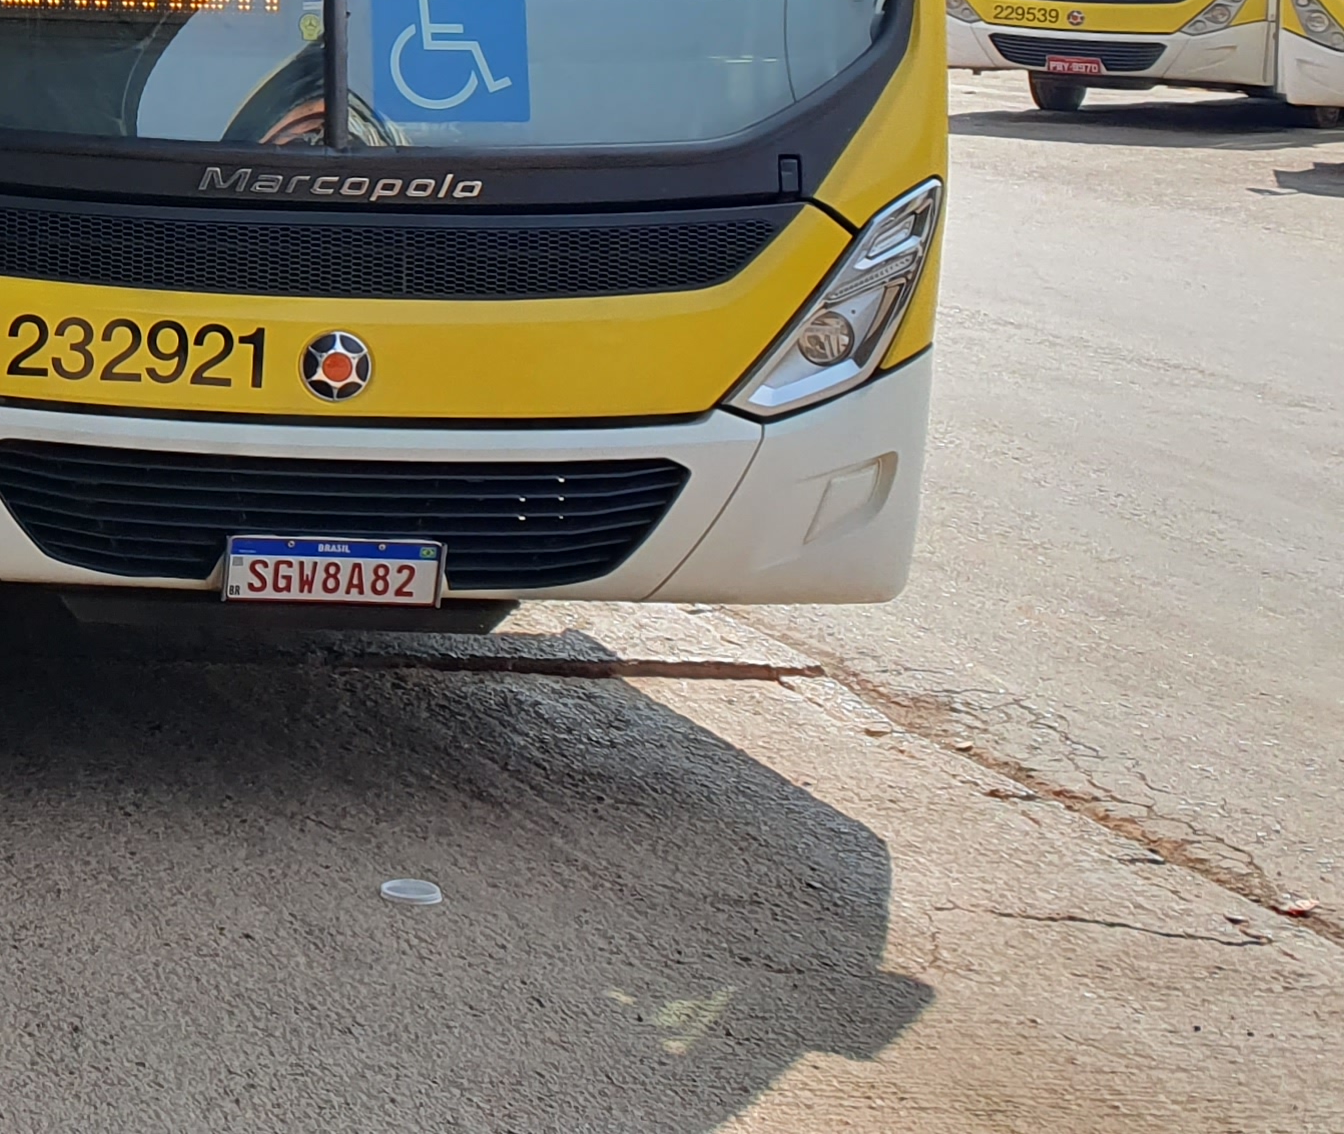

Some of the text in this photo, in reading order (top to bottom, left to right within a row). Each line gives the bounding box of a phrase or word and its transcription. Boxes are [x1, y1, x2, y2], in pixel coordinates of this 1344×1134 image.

[993, 4, 1060, 24] 229539
[198, 167, 483, 202] Marcopolo
[6, 313, 266, 389] 232921
[318, 544, 351, 554] BRASIL
[229, 585, 241, 596] BR
[247, 559, 416, 598] SGW8A82
